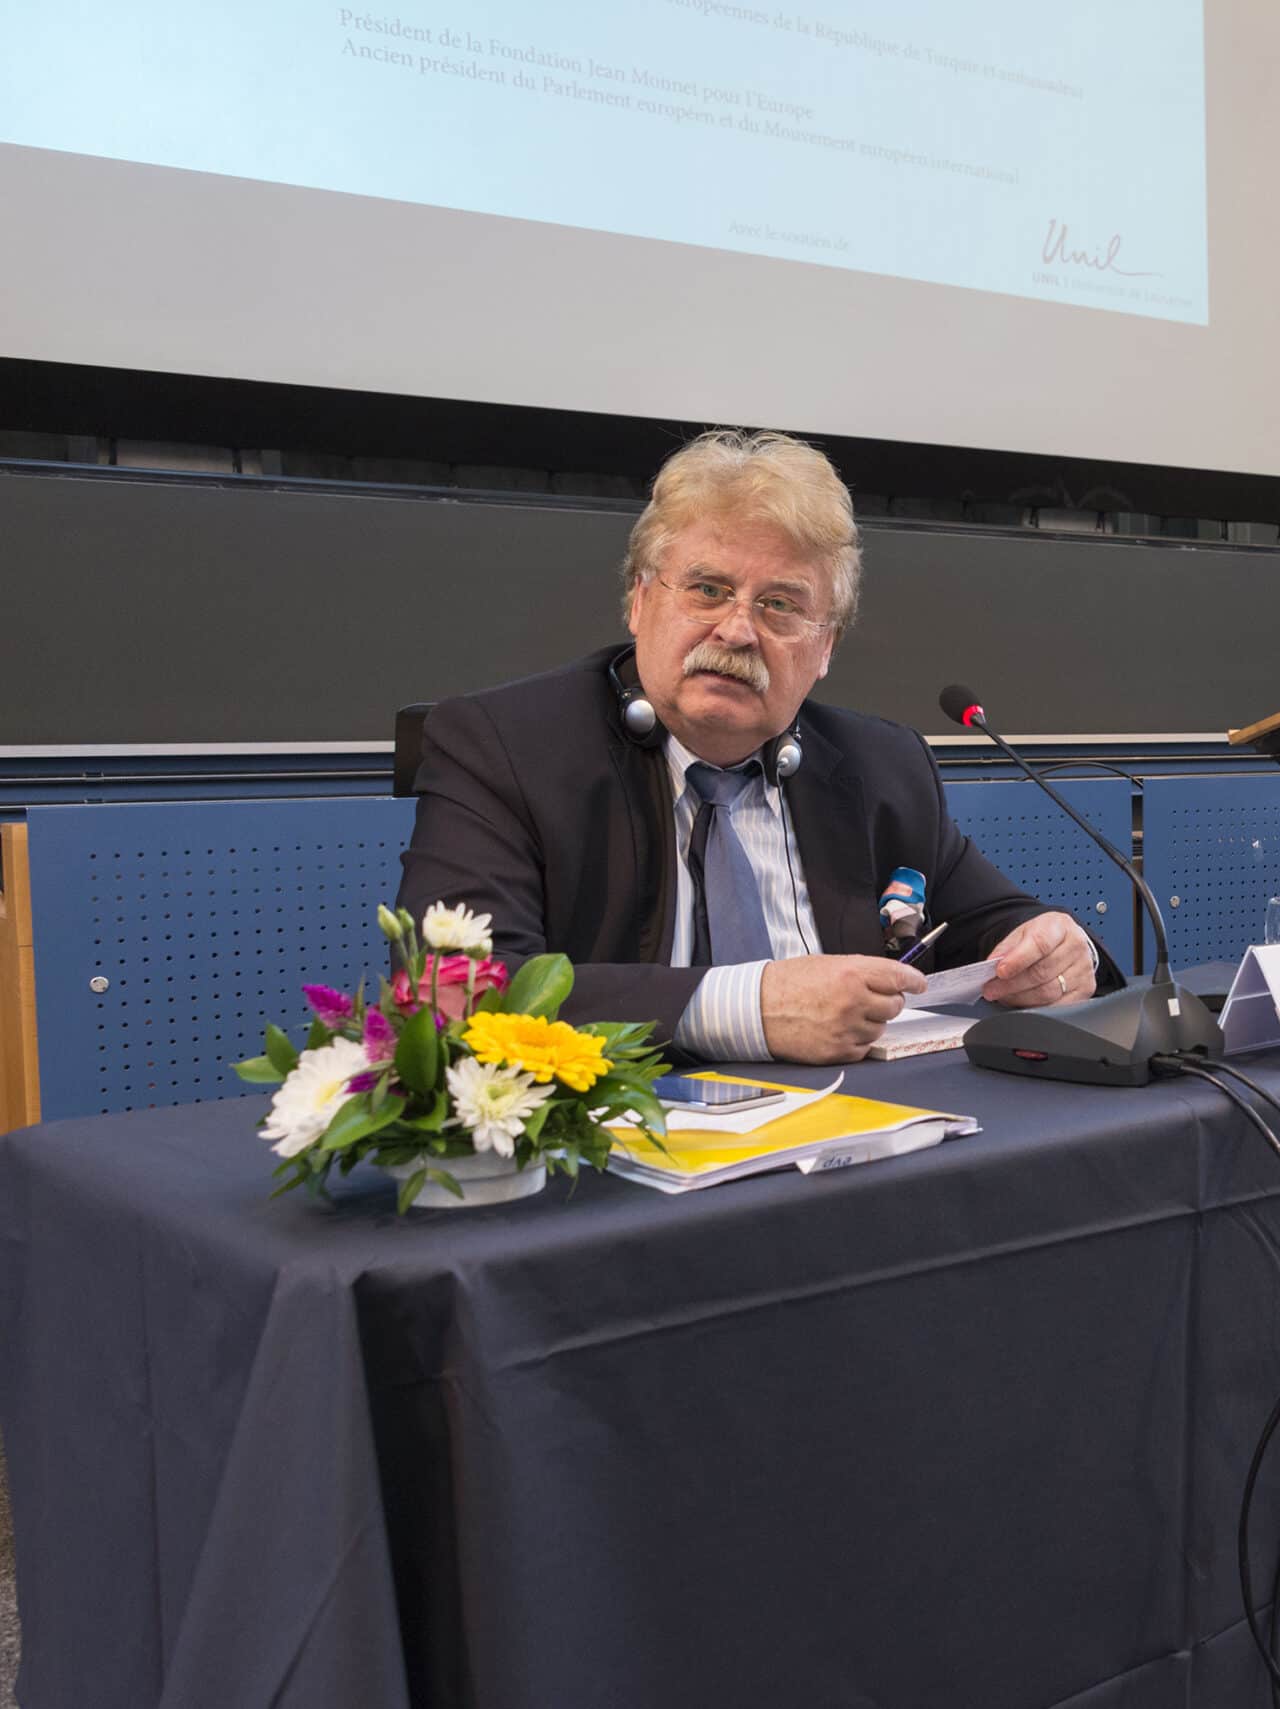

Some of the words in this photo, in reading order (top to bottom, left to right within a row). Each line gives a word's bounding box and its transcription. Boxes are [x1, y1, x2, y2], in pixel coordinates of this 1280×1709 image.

[339, 8, 432, 44] Président
[439, 28, 462, 49] de
[467, 32, 482, 54] la
[490, 38, 582, 74] Fondation
[587, 58, 625, 82] Jean
[631, 67, 697, 97] Monnet
[703, 85, 740, 107] pour
[342, 38, 413, 68] Ancien
[419, 56, 506, 85] président
[512, 69, 536, 91] du
[543, 76, 630, 108] Parlement
[637, 98, 715, 127] européen
[719, 111, 734, 130] et
[738, 114, 760, 135] du
[764, 119, 856, 153] Mouvement
